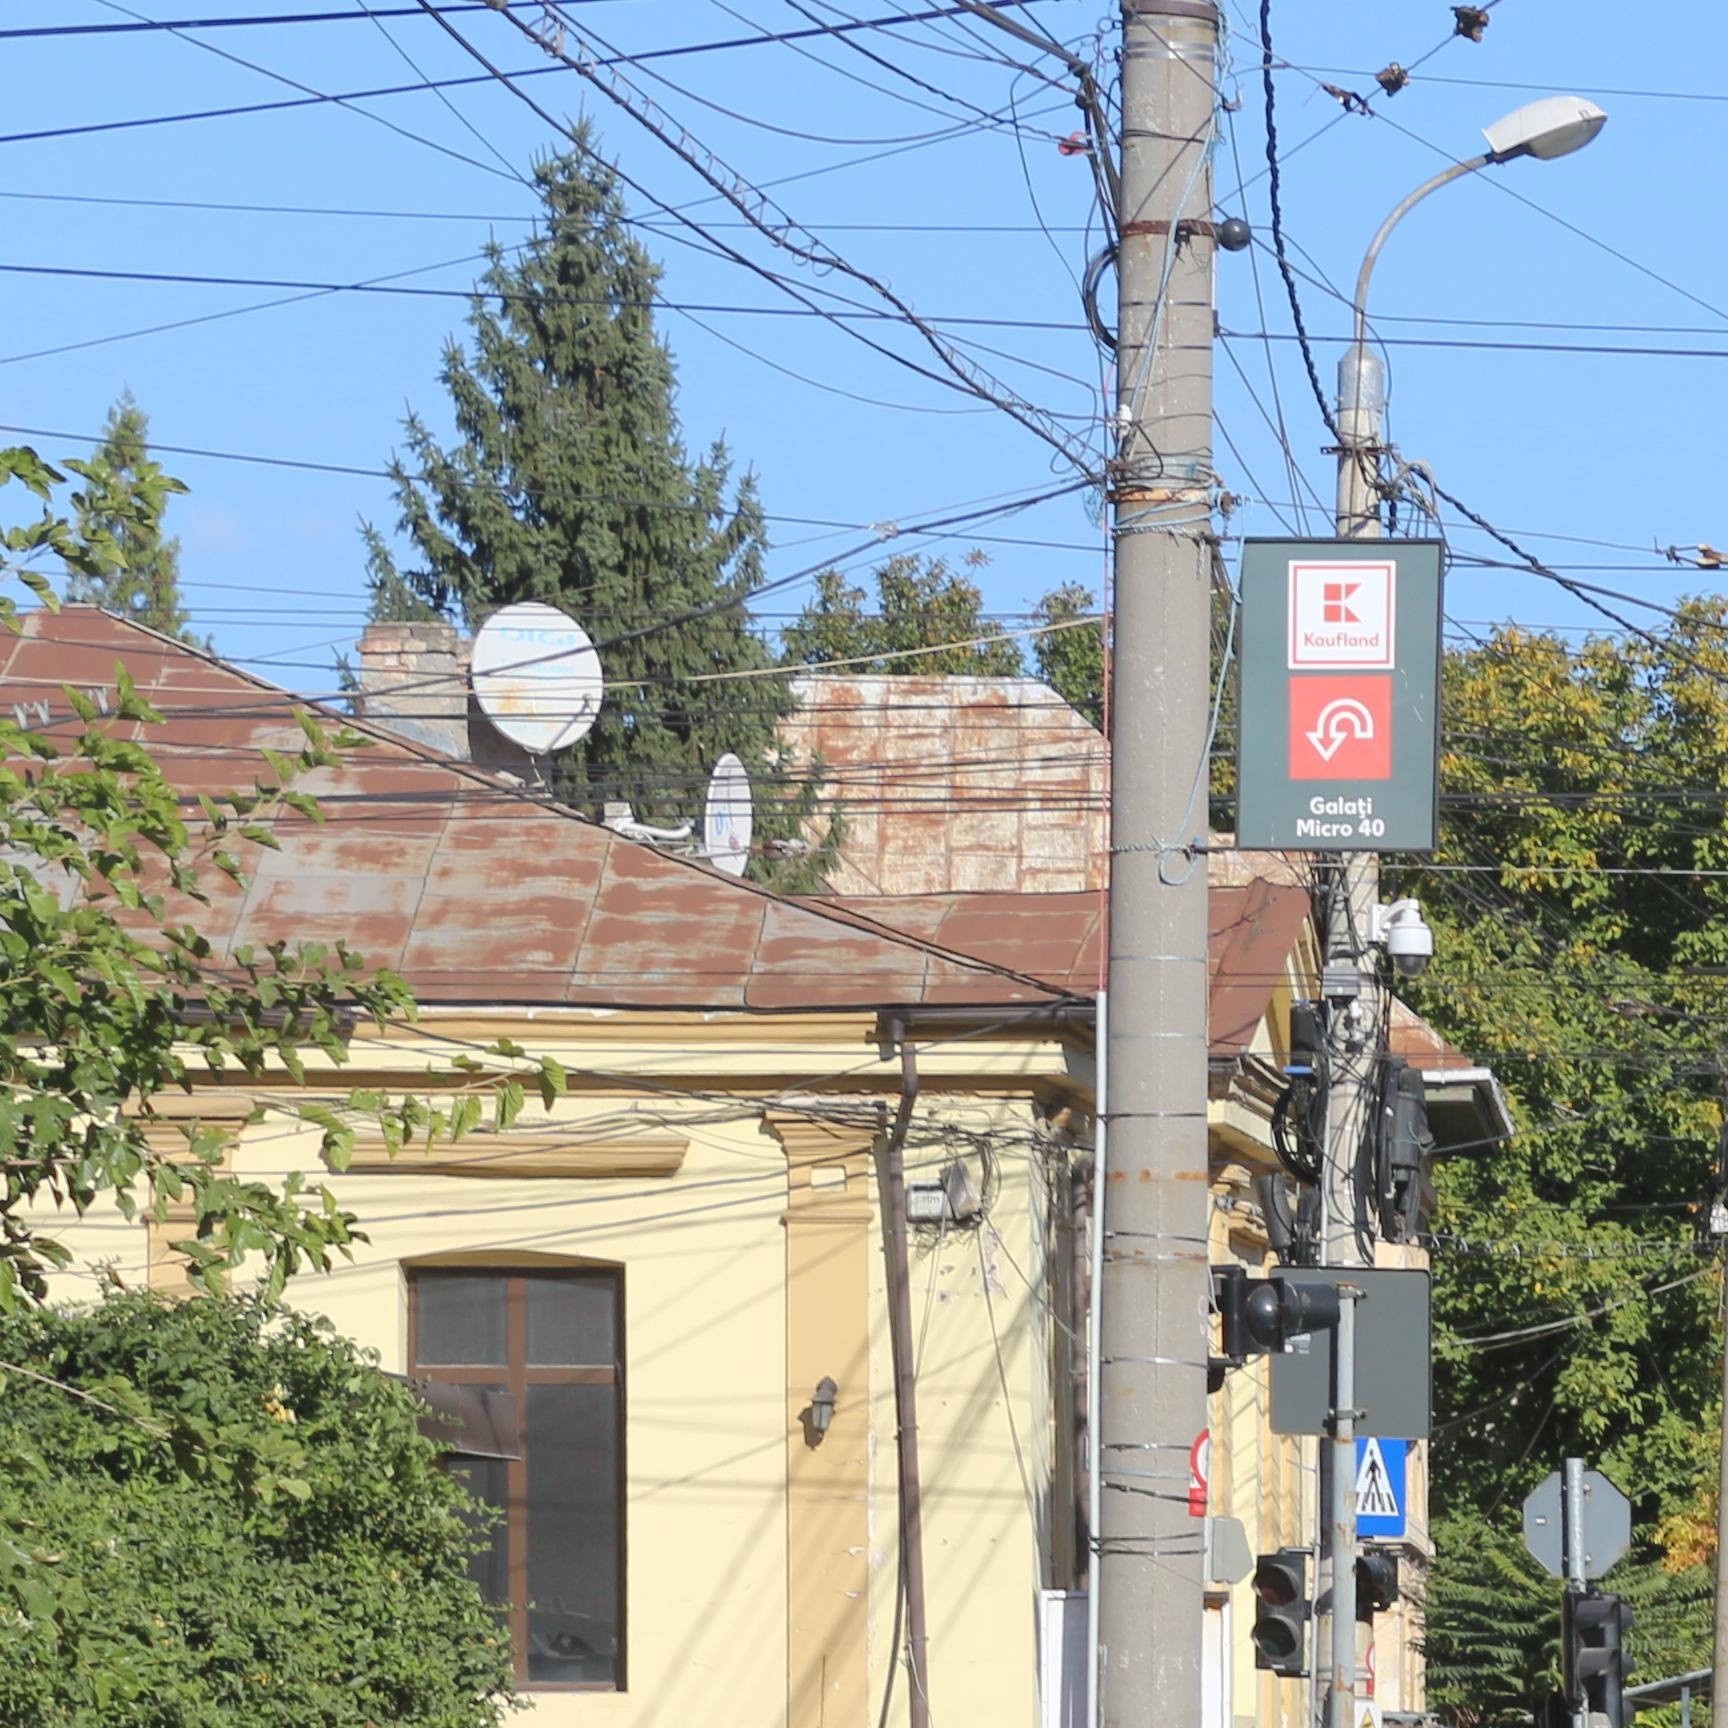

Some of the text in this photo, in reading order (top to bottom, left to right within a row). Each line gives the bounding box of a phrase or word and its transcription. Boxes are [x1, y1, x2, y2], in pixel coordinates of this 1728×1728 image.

[1304, 632, 1380, 648] Kaufland
[1296, 819, 1385, 838] Micro 40
